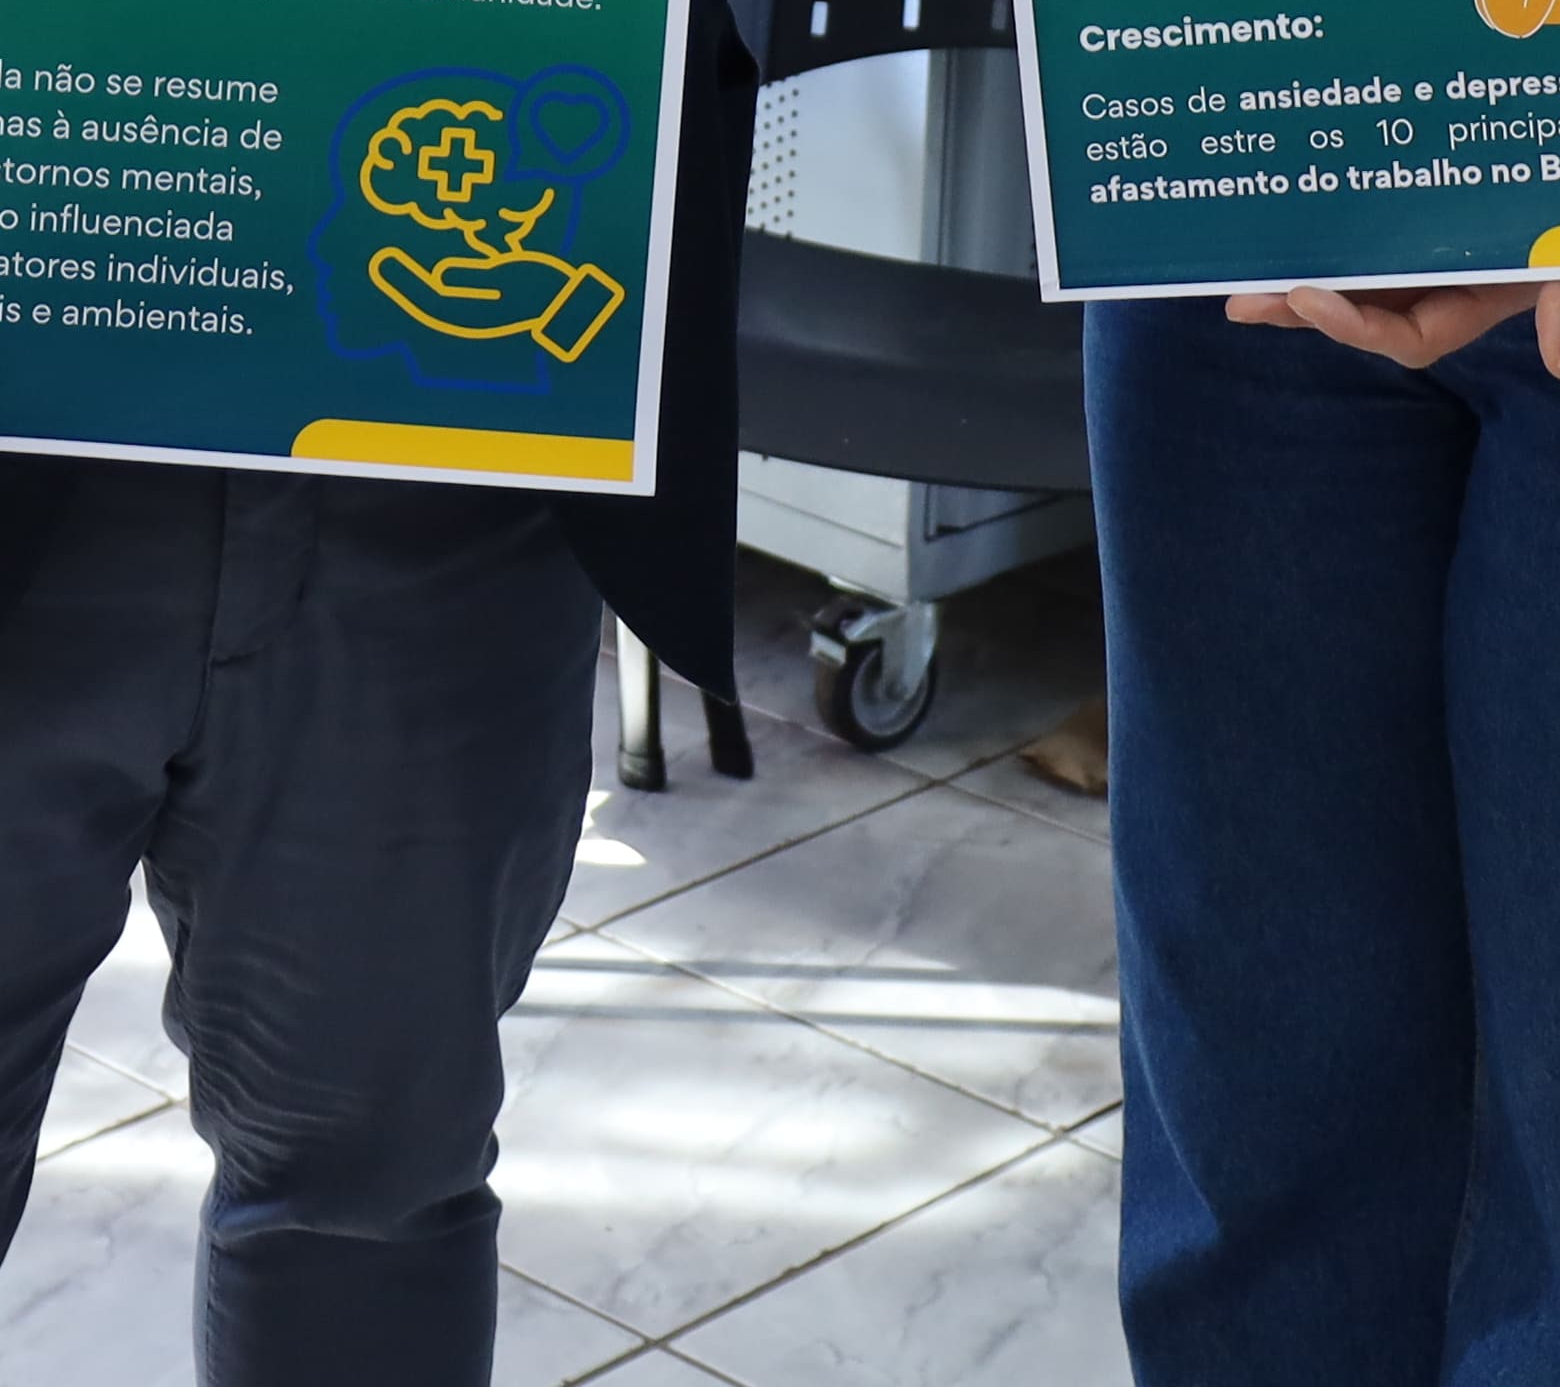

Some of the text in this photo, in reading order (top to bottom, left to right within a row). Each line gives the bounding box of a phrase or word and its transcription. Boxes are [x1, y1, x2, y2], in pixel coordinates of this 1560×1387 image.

[1079, 13, 1324, 53] Crescimento:
[34, 63, 96, 94] não
[105, 73, 143, 97] se
[153, 76, 279, 104] resume
[1081, 93, 1175, 120] Casos
[1187, 85, 1226, 114] de
[1239, 75, 1402, 111] ansiedade
[1414, 81, 1434, 102] e
[52, 109, 71, 140] à
[81, 113, 229, 148] ausência
[239, 119, 283, 151] de
[1086, 132, 1168, 162] estão
[1200, 129, 1276, 156] estre
[1309, 128, 1345, 150] os
[1375, 117, 1414, 147] 10
[121, 166, 262, 201] mentais,
[1090, 170, 1290, 204] afastamento
[1297, 164, 1340, 193] do
[1346, 157, 1483, 191] trabalho
[1491, 162, 1532, 184] no
[30, 202, 234, 242] influenciada
[107, 253, 294, 296] individuais,
[31, 303, 52, 325] e
[61, 299, 253, 335] ambientais.
